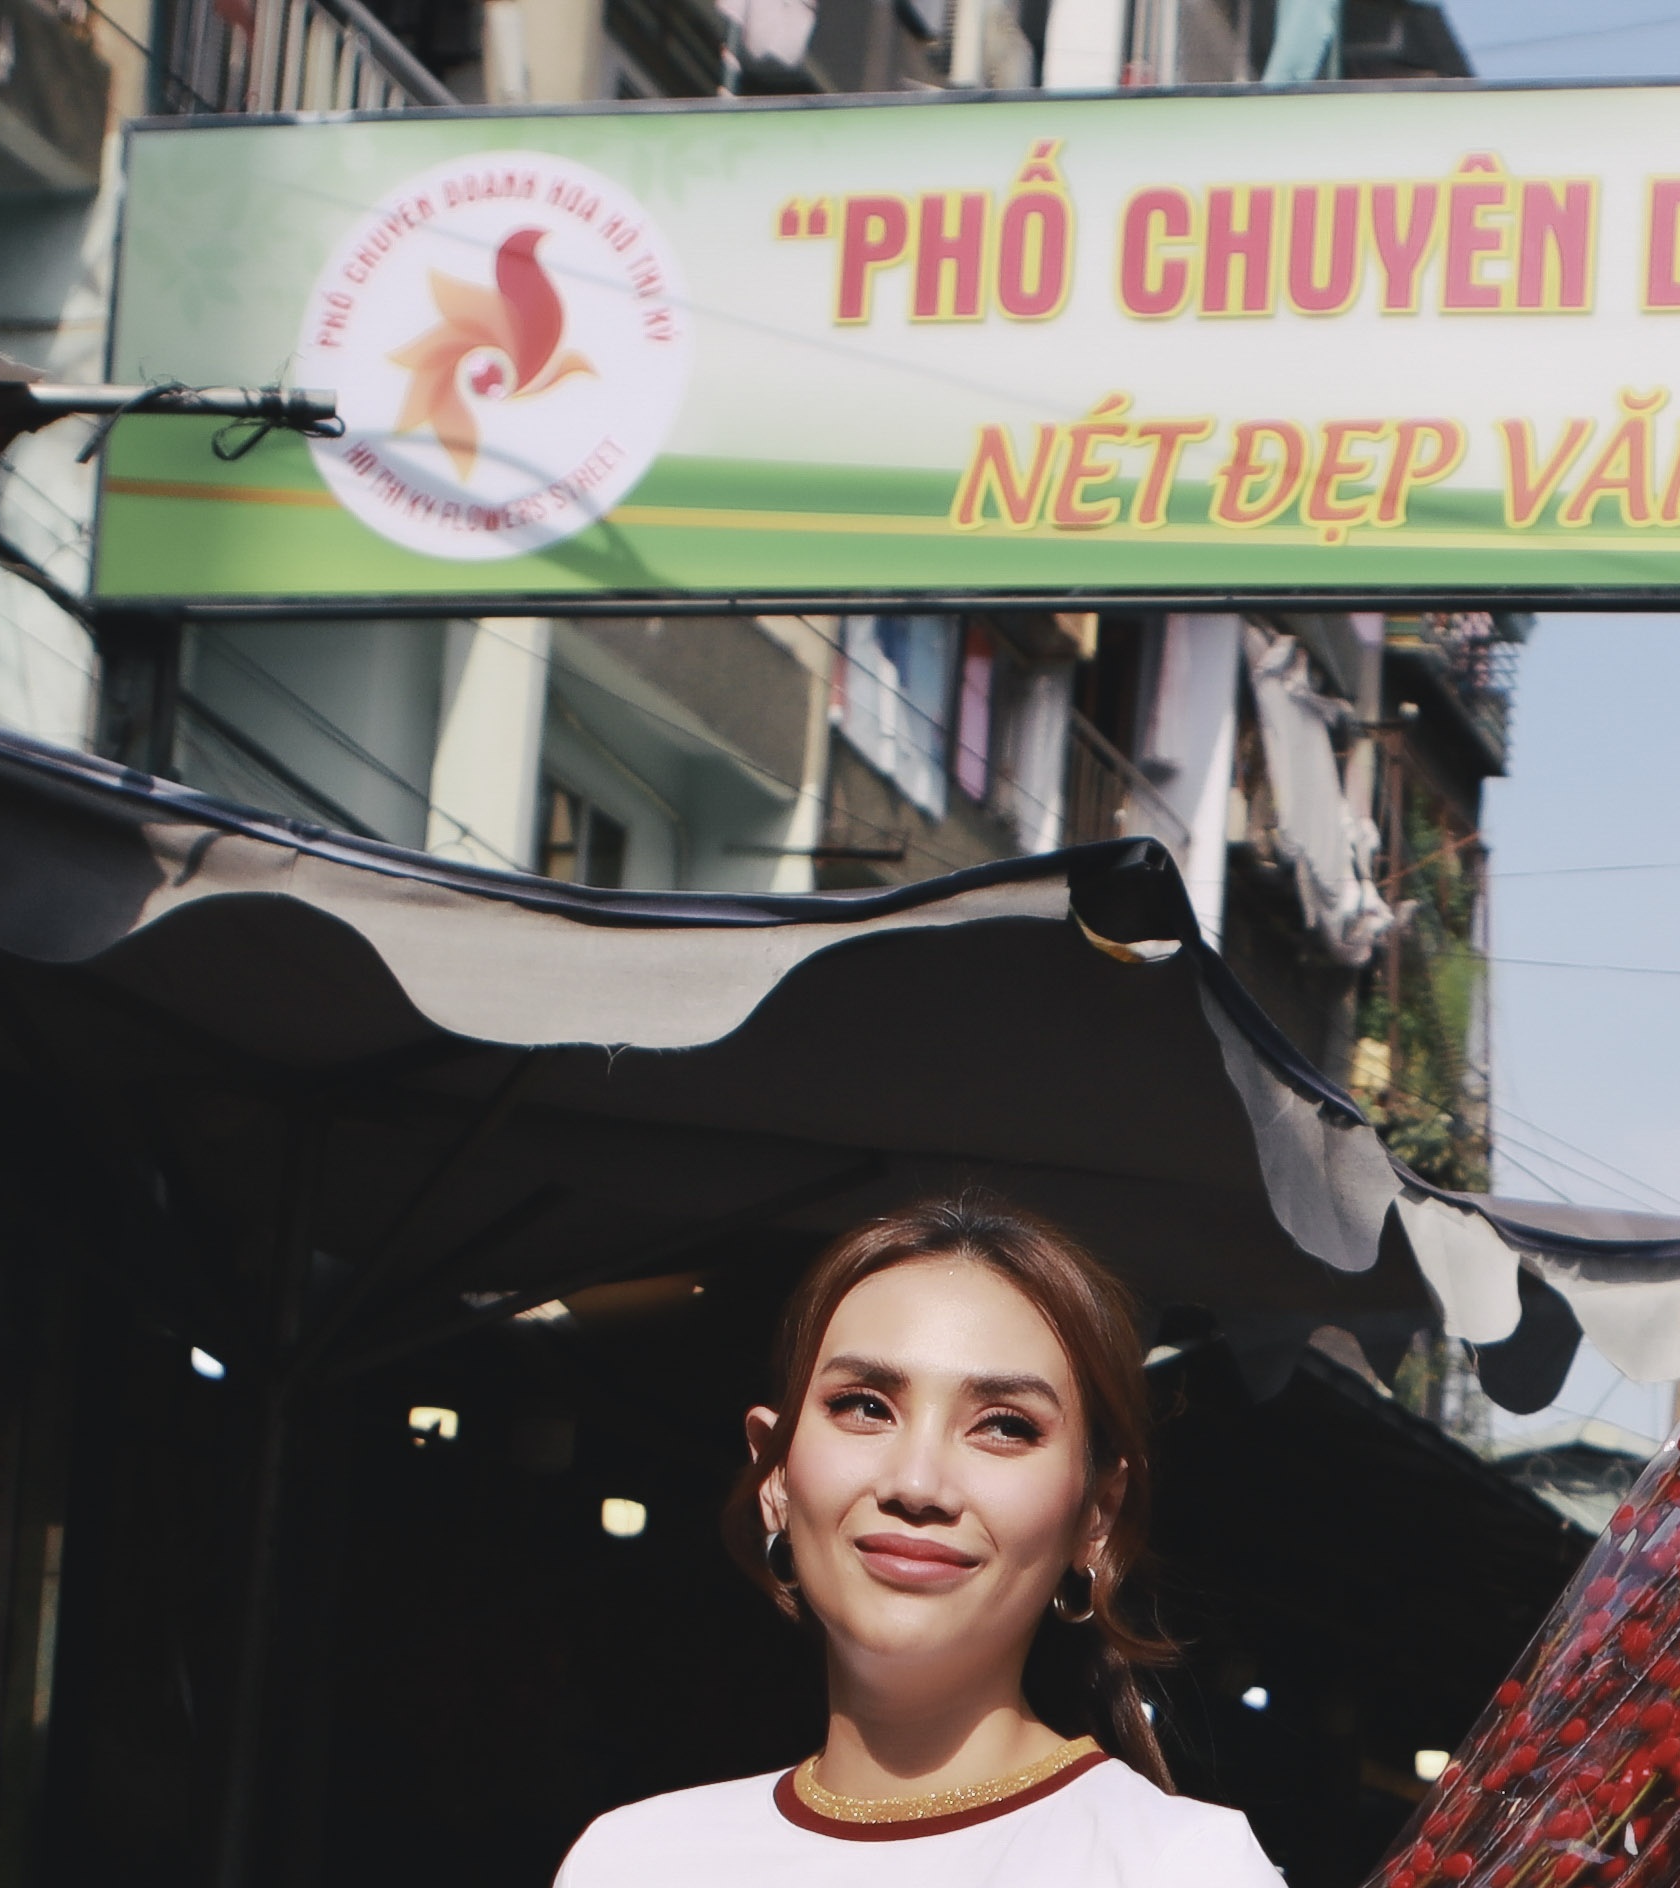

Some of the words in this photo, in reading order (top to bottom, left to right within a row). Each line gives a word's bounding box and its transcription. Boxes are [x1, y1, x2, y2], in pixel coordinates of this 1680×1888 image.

[546, 173, 604, 223] HOA
[1119, 155, 1596, 318] CHUYÊN
[950, 392, 1220, 533] NÉT
[1211, 413, 1469, 550] ĐẸP
